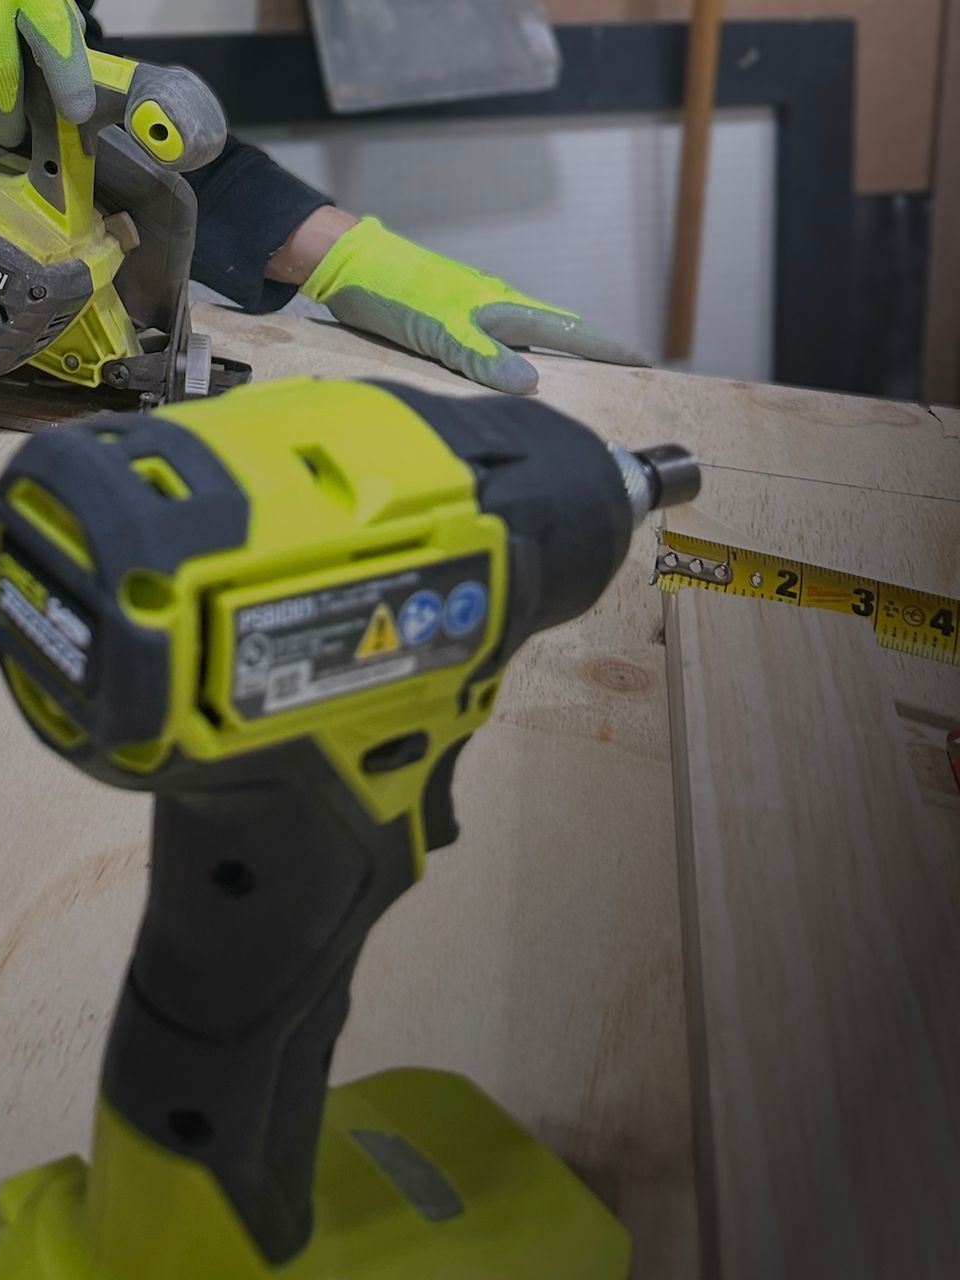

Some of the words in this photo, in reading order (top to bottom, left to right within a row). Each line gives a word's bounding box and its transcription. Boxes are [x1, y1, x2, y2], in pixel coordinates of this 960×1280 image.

[775, 569, 799, 599] 2
[851, 588, 875, 617] 3
[929, 608, 954, 637] 4
